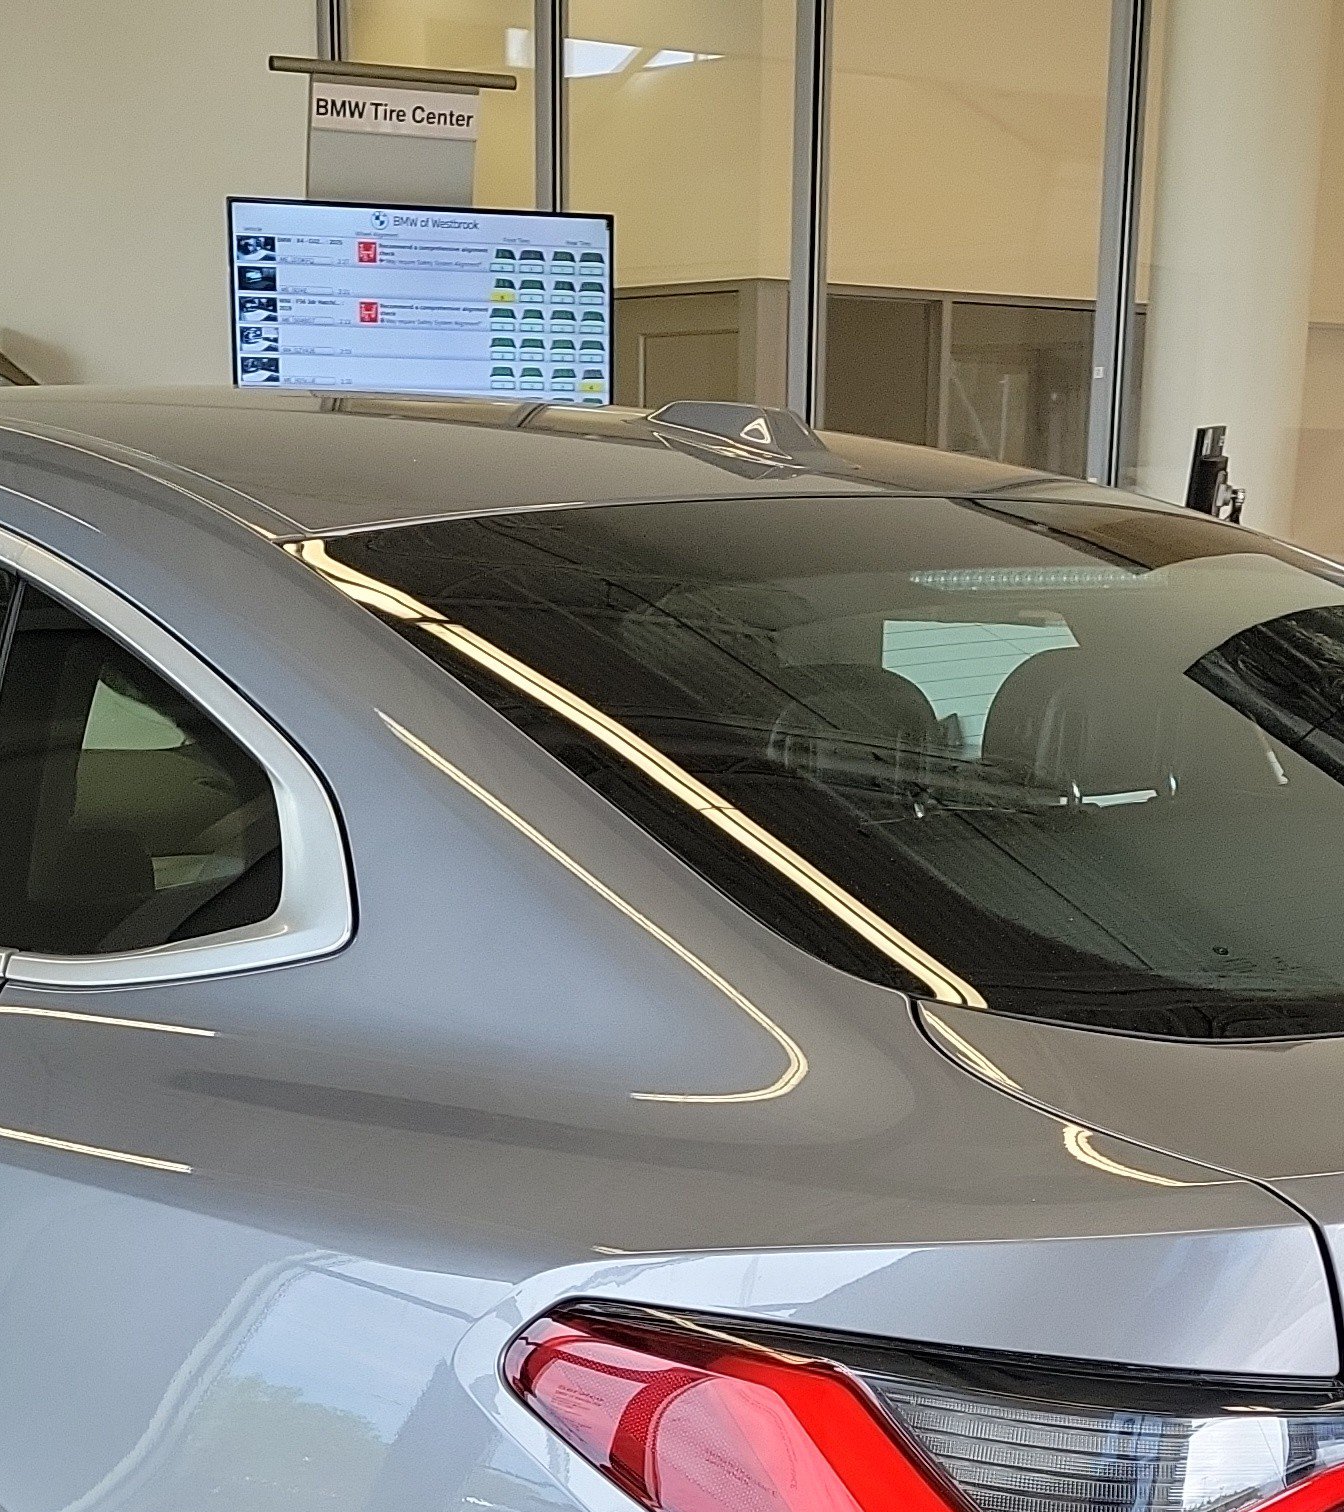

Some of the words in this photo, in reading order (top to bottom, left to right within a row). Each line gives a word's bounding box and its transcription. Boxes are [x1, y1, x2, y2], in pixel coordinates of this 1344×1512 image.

[315, 97, 367, 119] BMW
[370, 102, 407, 123] Tire
[412, 105, 475, 128] Center
[393, 215, 418, 228] BMW
[420, 216, 430, 229] of
[431, 218, 480, 231] Westbrook
